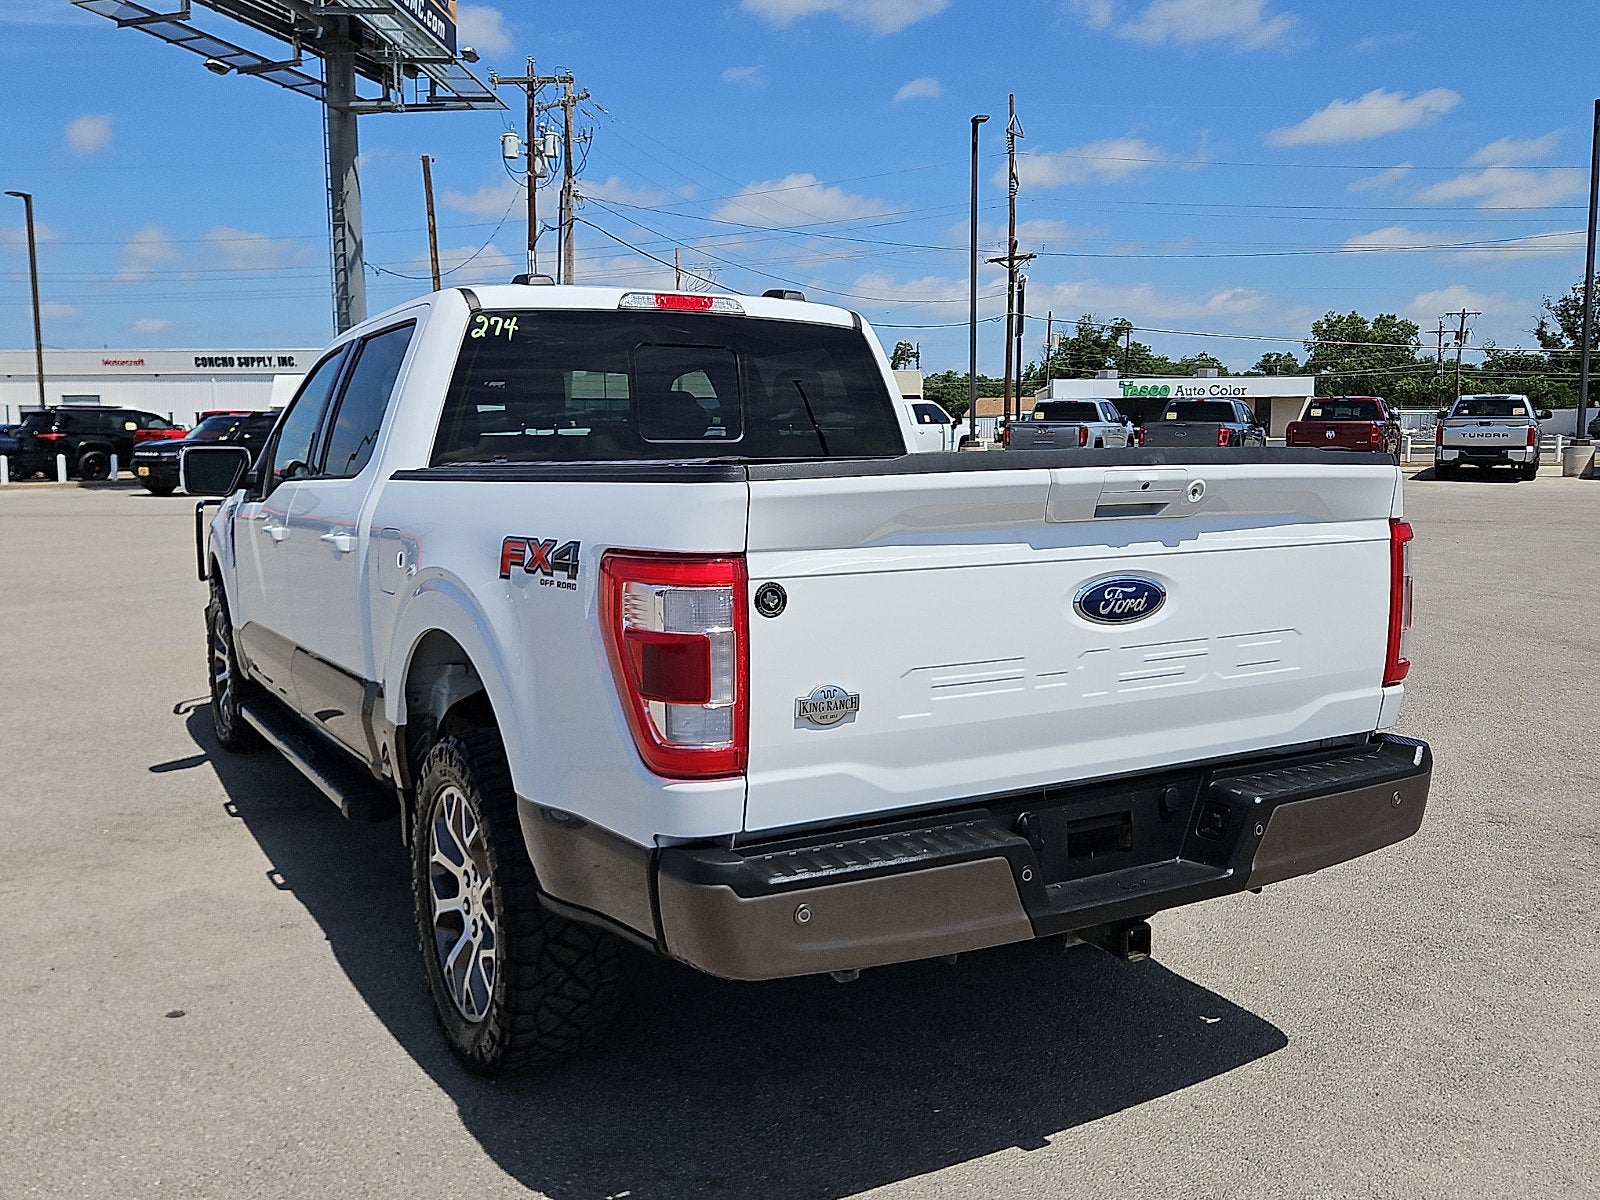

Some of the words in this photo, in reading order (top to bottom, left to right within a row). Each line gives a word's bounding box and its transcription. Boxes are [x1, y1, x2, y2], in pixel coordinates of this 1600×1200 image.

[471, 315, 519, 341] 274
[194, 356, 235, 367] CONCHO
[237, 356, 276, 368] SUPPLY,
[277, 356, 298, 367] INC.
[1119, 380, 1171, 396] TASCO
[1175, 385, 1206, 396] Auto
[1209, 384, 1248, 396] Color
[499, 535, 582, 580] FX4
[540, 578, 555, 587] OFF
[557, 581, 577, 591] ROAD
[1099, 586, 1149, 615] Ford
[897, 627, 1303, 719] F-150
[802, 701, 825, 714] KING
[826, 696, 857, 711] RANCH
